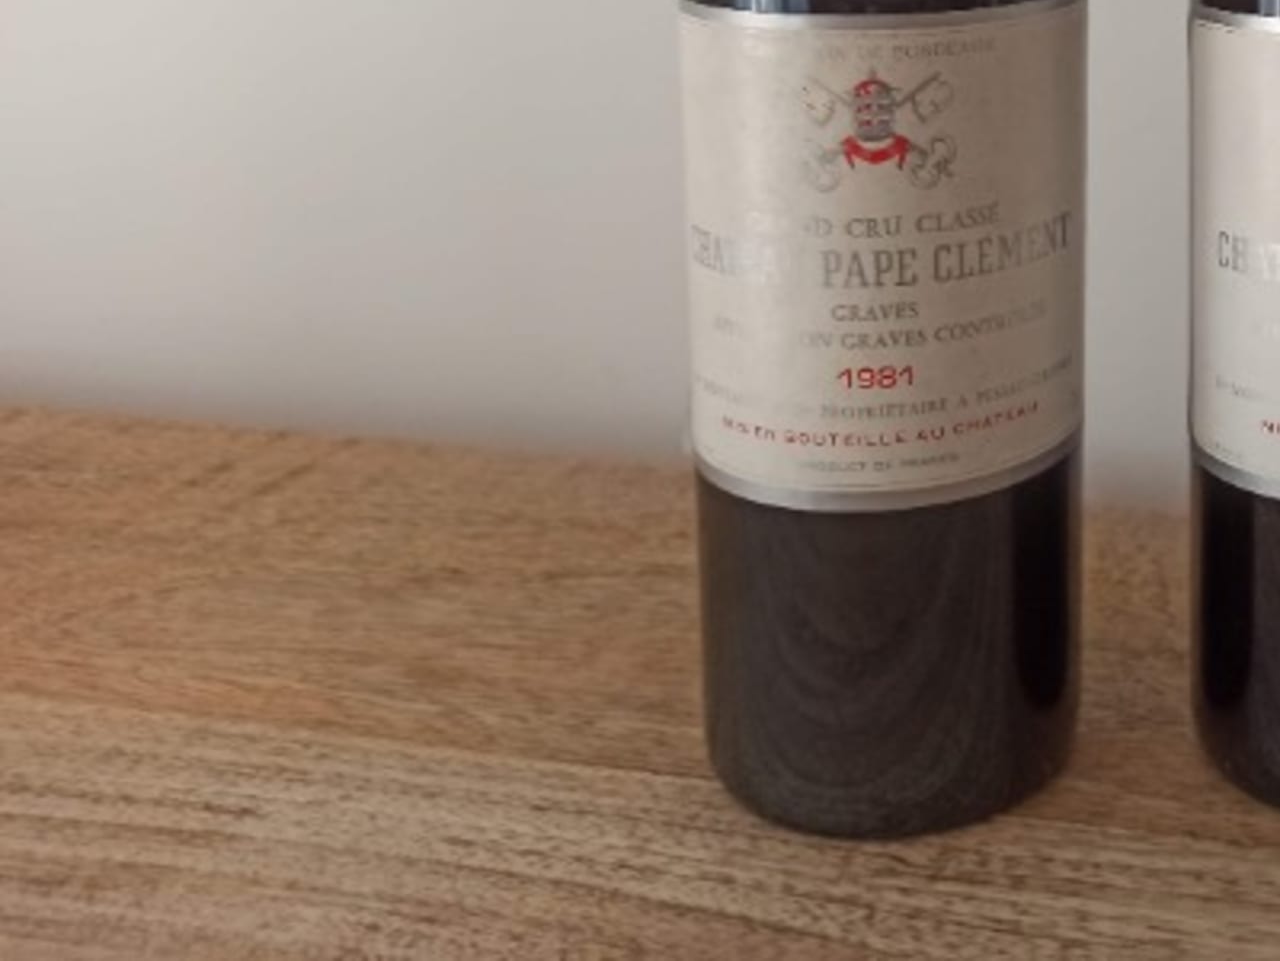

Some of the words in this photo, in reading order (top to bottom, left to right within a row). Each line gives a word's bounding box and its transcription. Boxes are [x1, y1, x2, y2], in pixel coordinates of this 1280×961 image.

[846, 216, 903, 240] CRU
[819, 248, 919, 289] PAPE
[830, 302, 920, 323] GRAVES
[840, 328, 929, 352] GRAVES
[835, 364, 916, 390] 1981
[754, 423, 777, 443] EN
[783, 428, 908, 448] BOUTEILLE
[916, 425, 946, 444] AU
